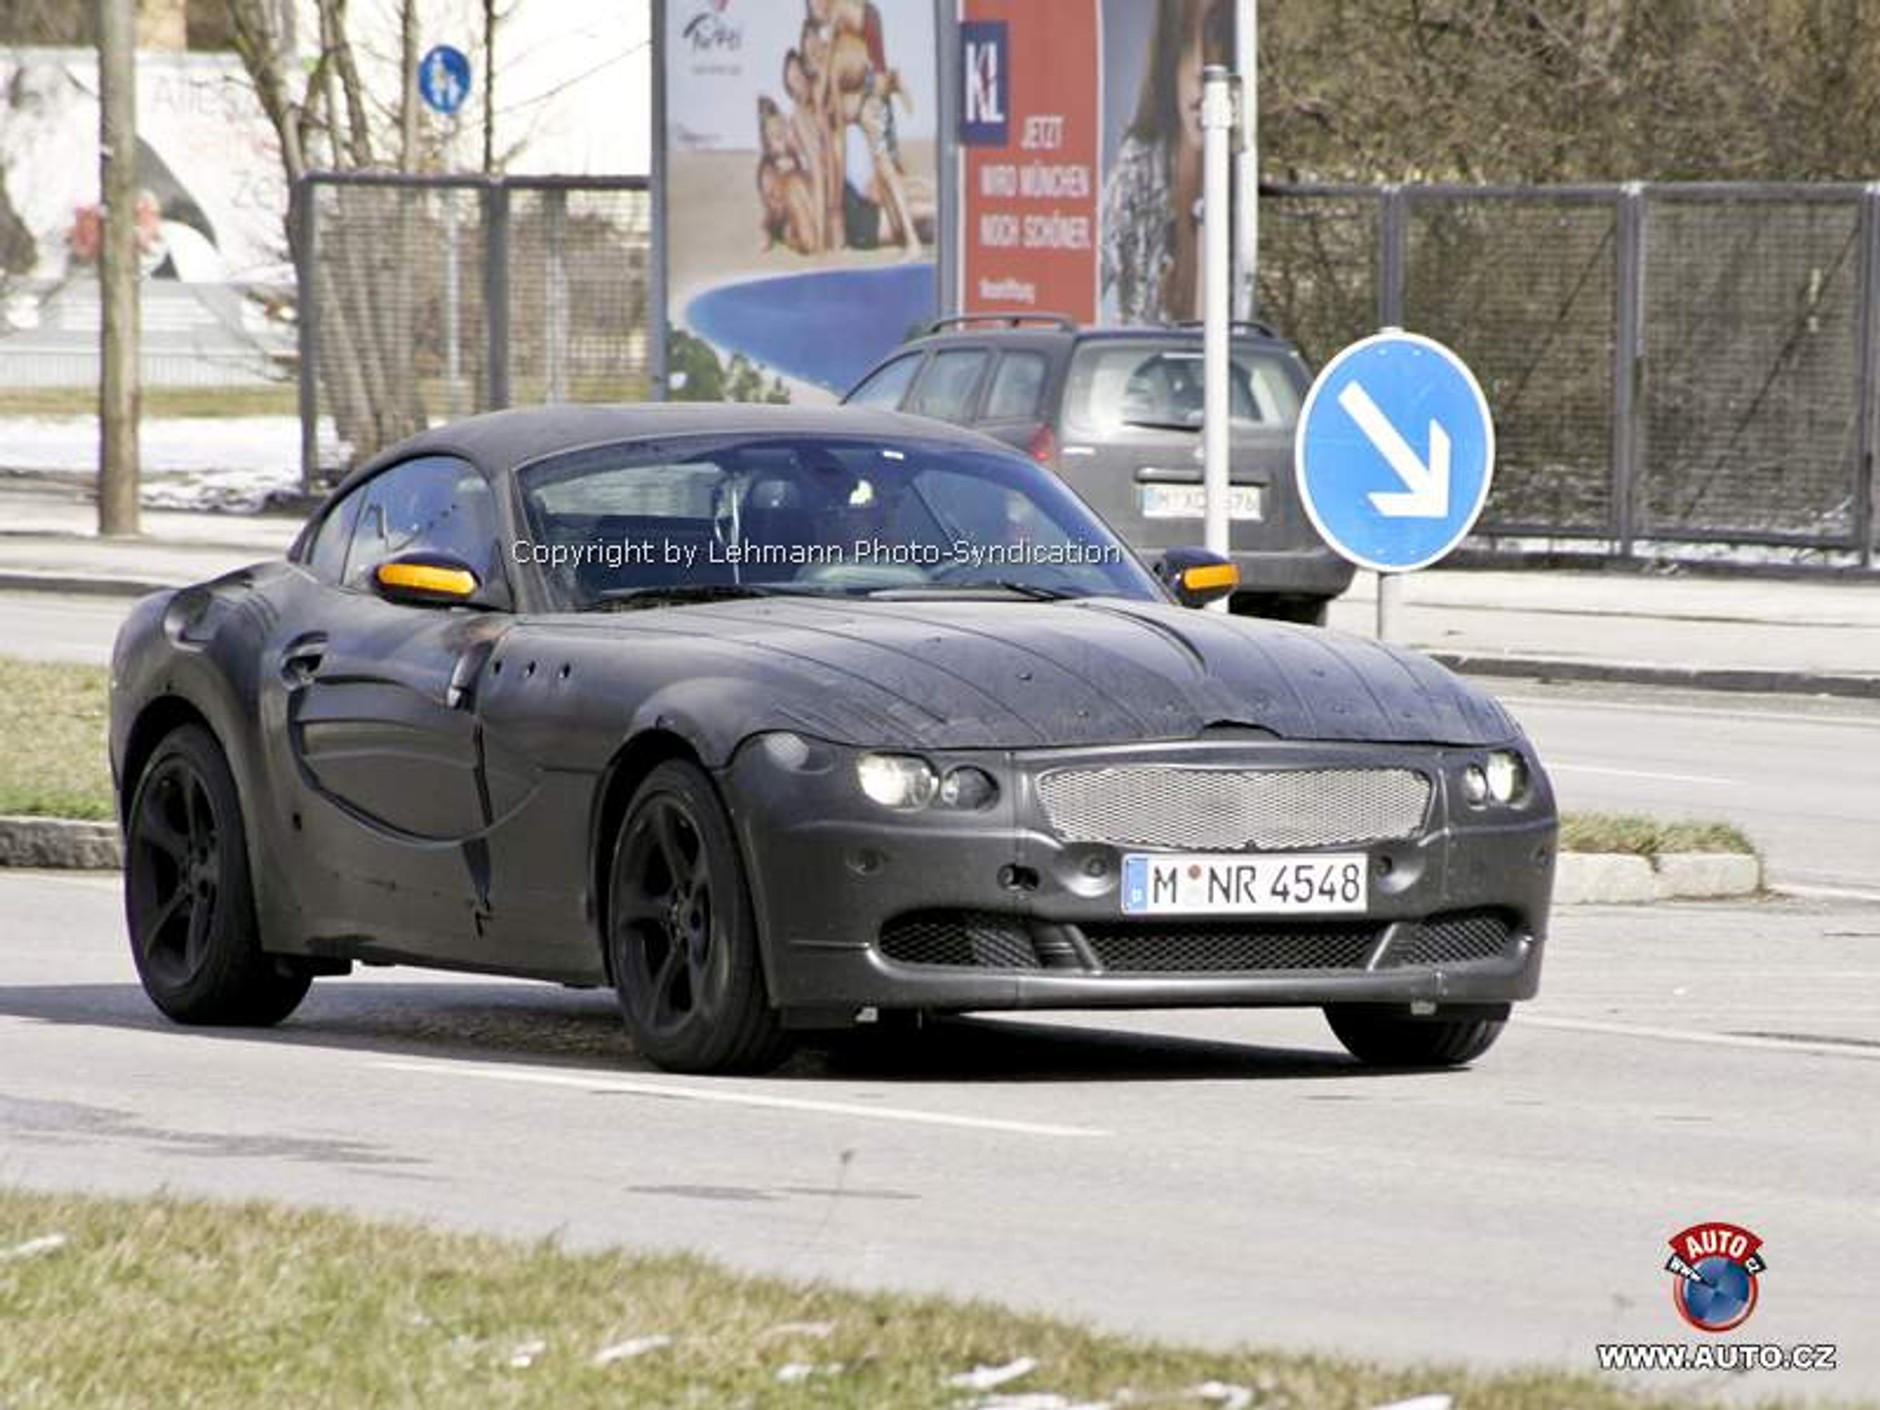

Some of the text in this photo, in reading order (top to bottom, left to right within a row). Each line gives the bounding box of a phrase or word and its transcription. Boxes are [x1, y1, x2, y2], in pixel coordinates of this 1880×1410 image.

[1020, 115, 1063, 149] JETZT
[1020, 159, 1090, 198] MÜNCHEN
[981, 214, 1018, 247] NOCH
[1153, 866, 1177, 904] M
[1207, 866, 1257, 904] NR
[1270, 864, 1360, 904] 4548
